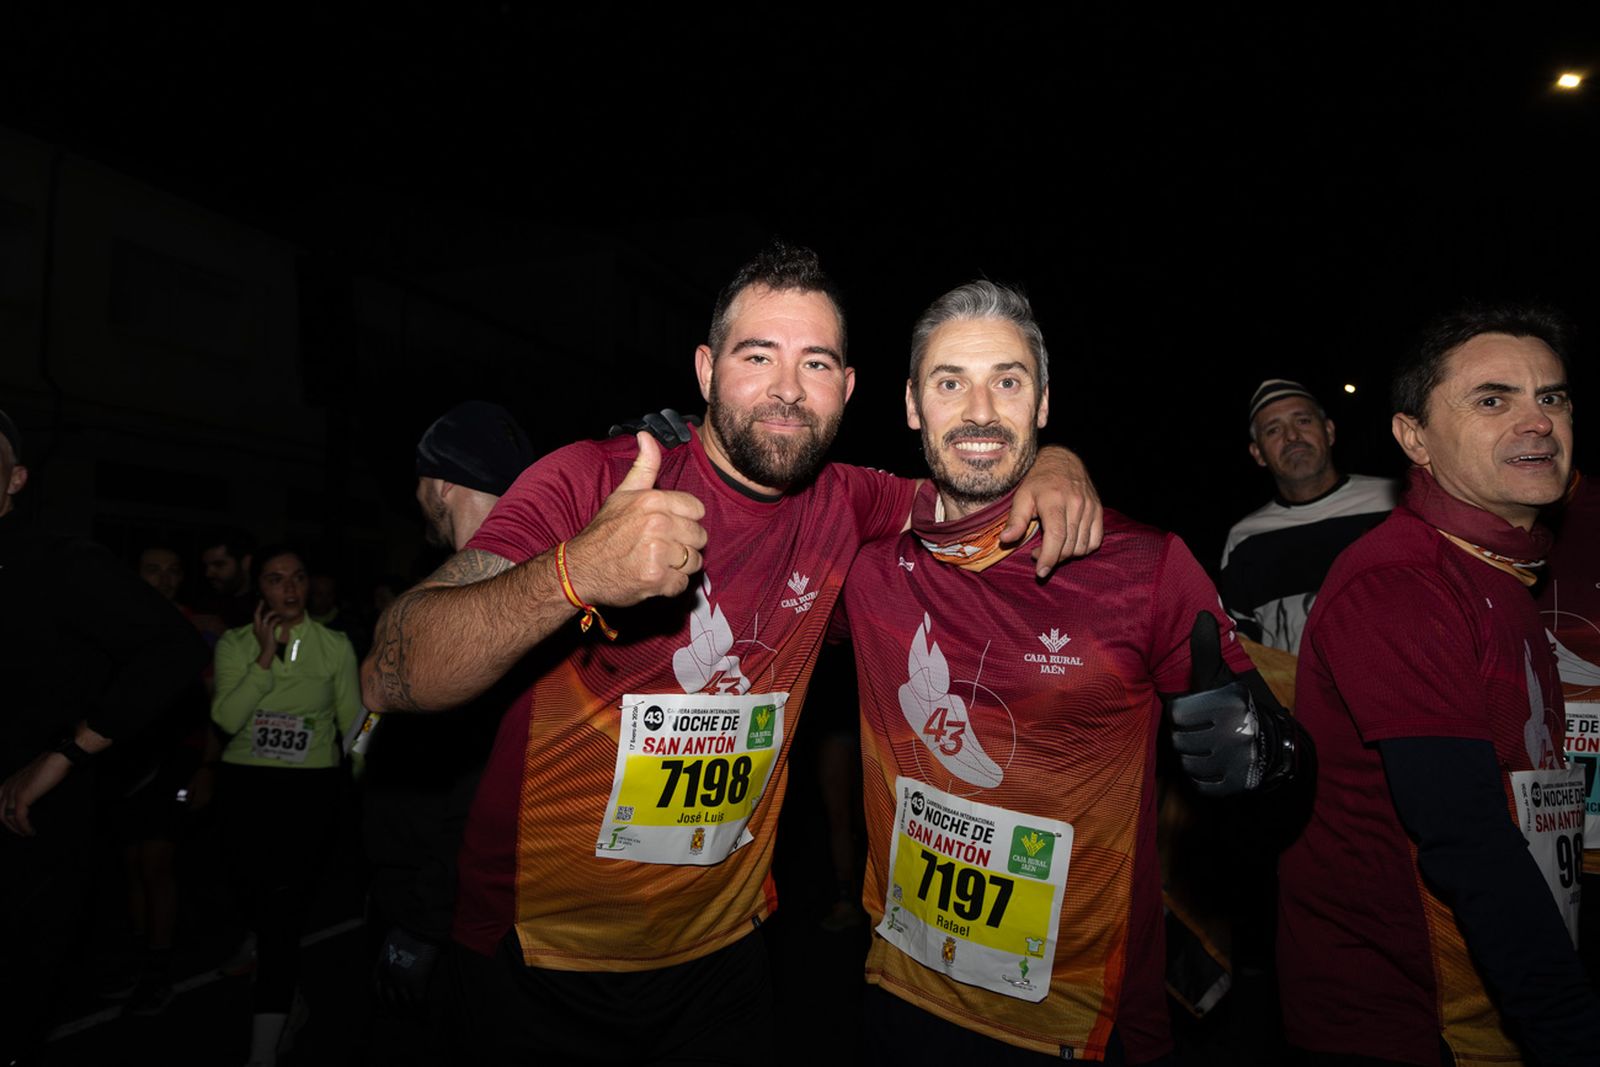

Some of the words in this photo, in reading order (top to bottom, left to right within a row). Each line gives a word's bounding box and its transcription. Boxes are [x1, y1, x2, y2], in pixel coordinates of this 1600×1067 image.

[1024, 653, 1047, 663] CAJA
[1049, 655, 1084, 666] RURAL
[644, 711, 662, 724] 43
[721, 715, 740, 731] DE
[1579, 720, 1599, 733] DE
[257, 727, 308, 751] 3333
[923, 707, 966, 756] 43
[642, 736, 681, 755] SAN
[683, 731, 737, 755] ANTÓN
[656, 755, 752, 808] 7198
[911, 797, 924, 811] 43
[1543, 789, 1574, 807] NOCHE
[677, 811, 701, 824] José
[704, 811, 724, 823] Luis
[924, 806, 970, 837] NOCHE
[971, 824, 995, 844] DE
[959, 811, 995, 827] INTERNACIONAL
[1536, 812, 1556, 832] SAN
[907, 819, 933, 846] SAN
[933, 833, 991, 867] ANTÓN
[917, 849, 1014, 929] 7197
[936, 914, 970, 937] Rafael
